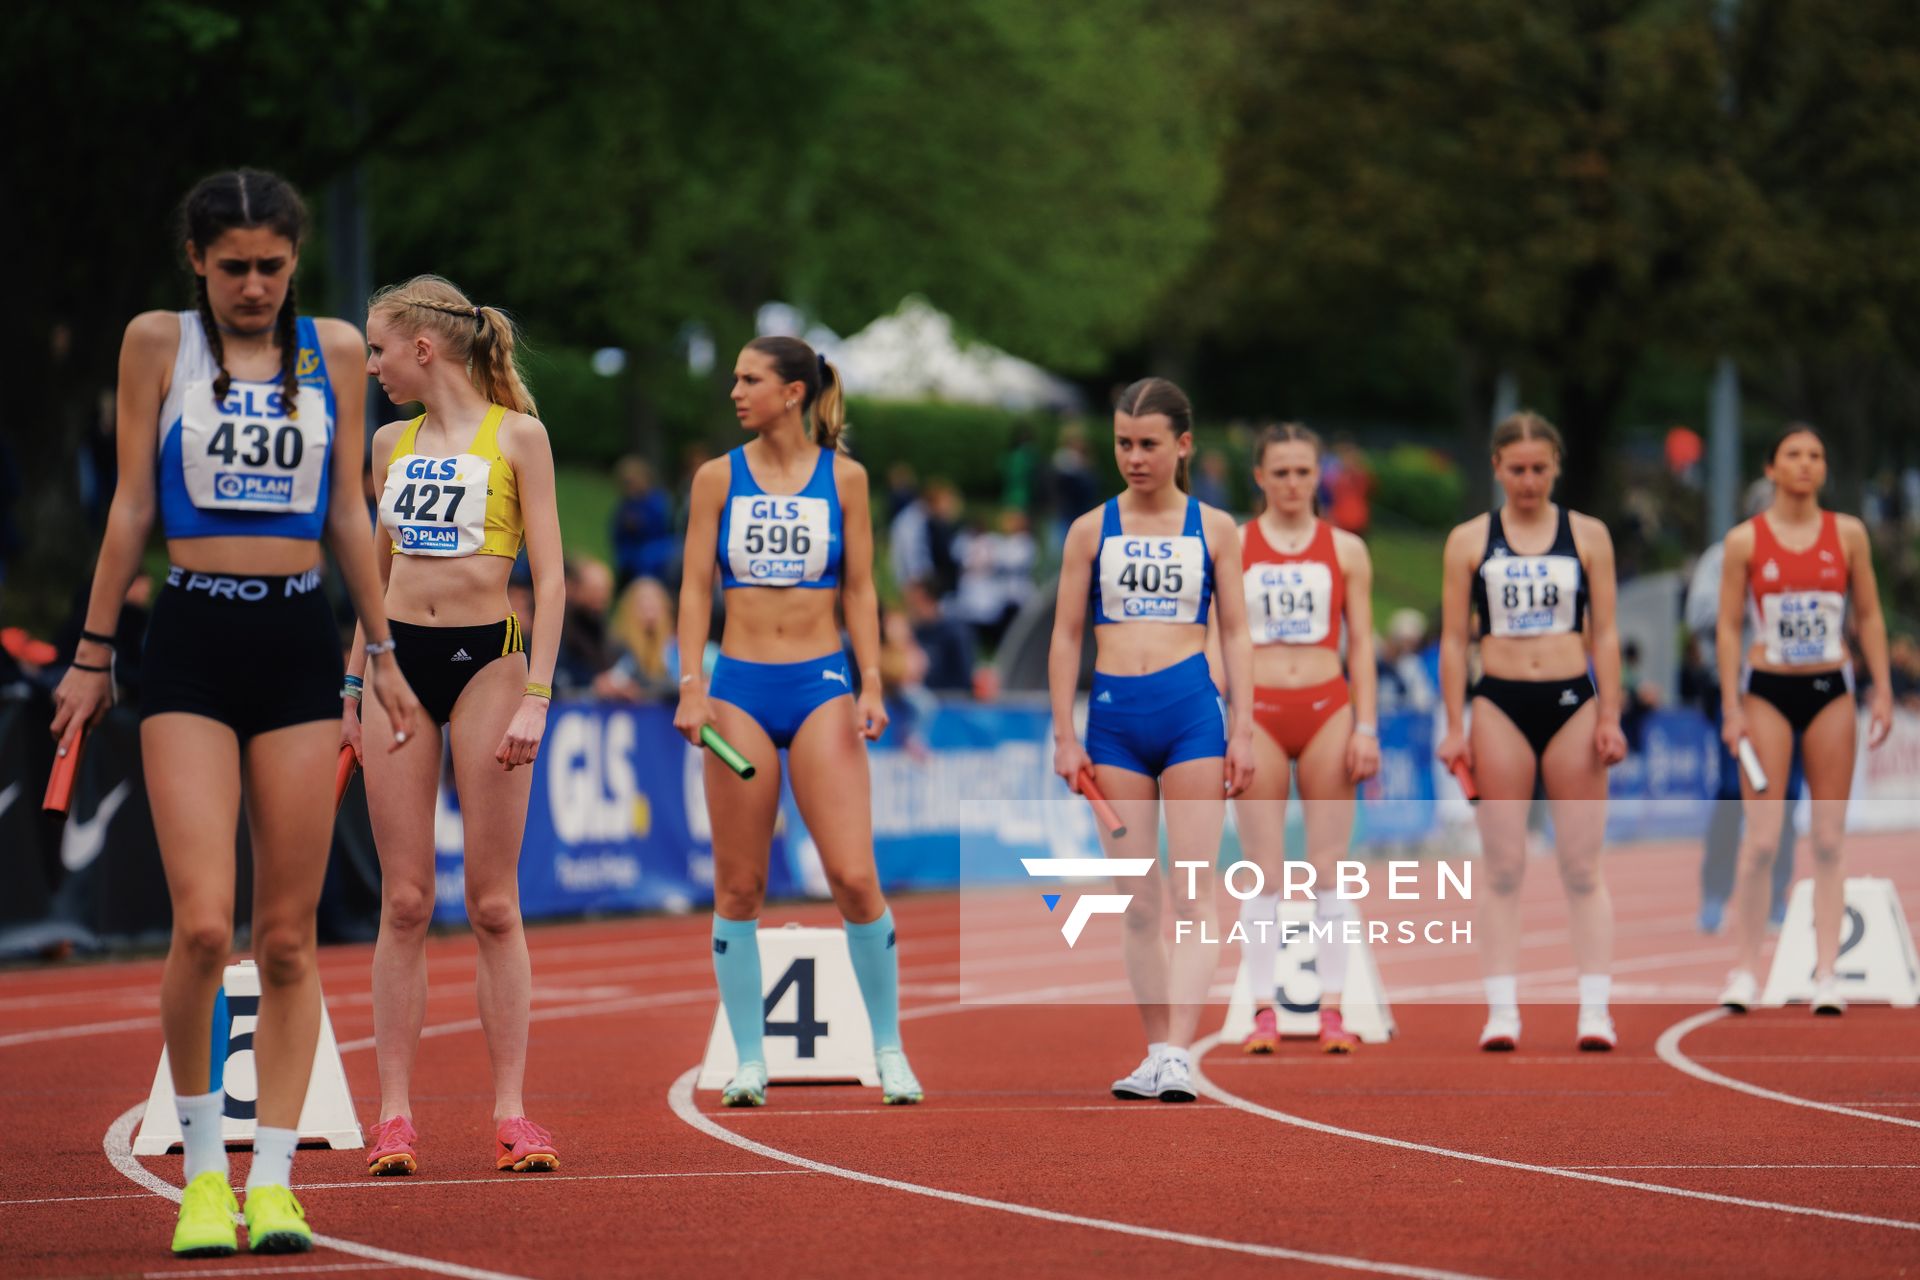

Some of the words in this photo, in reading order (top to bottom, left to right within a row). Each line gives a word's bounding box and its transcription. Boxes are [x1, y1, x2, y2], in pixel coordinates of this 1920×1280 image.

[207, 422, 304, 470] 430
[245, 477, 290, 495] PLAN
[393, 483, 466, 523] 427
[419, 530, 456, 542] PLAN
[745, 525, 811, 555] 596
[186, 575, 268, 601] PRO
[1118, 563, 1183, 593] 405
[1144, 600, 1176, 612] PLAN
[1261, 591, 1313, 615] 194
[1503, 584, 1558, 608] 818
[764, 958, 828, 1059] 4
